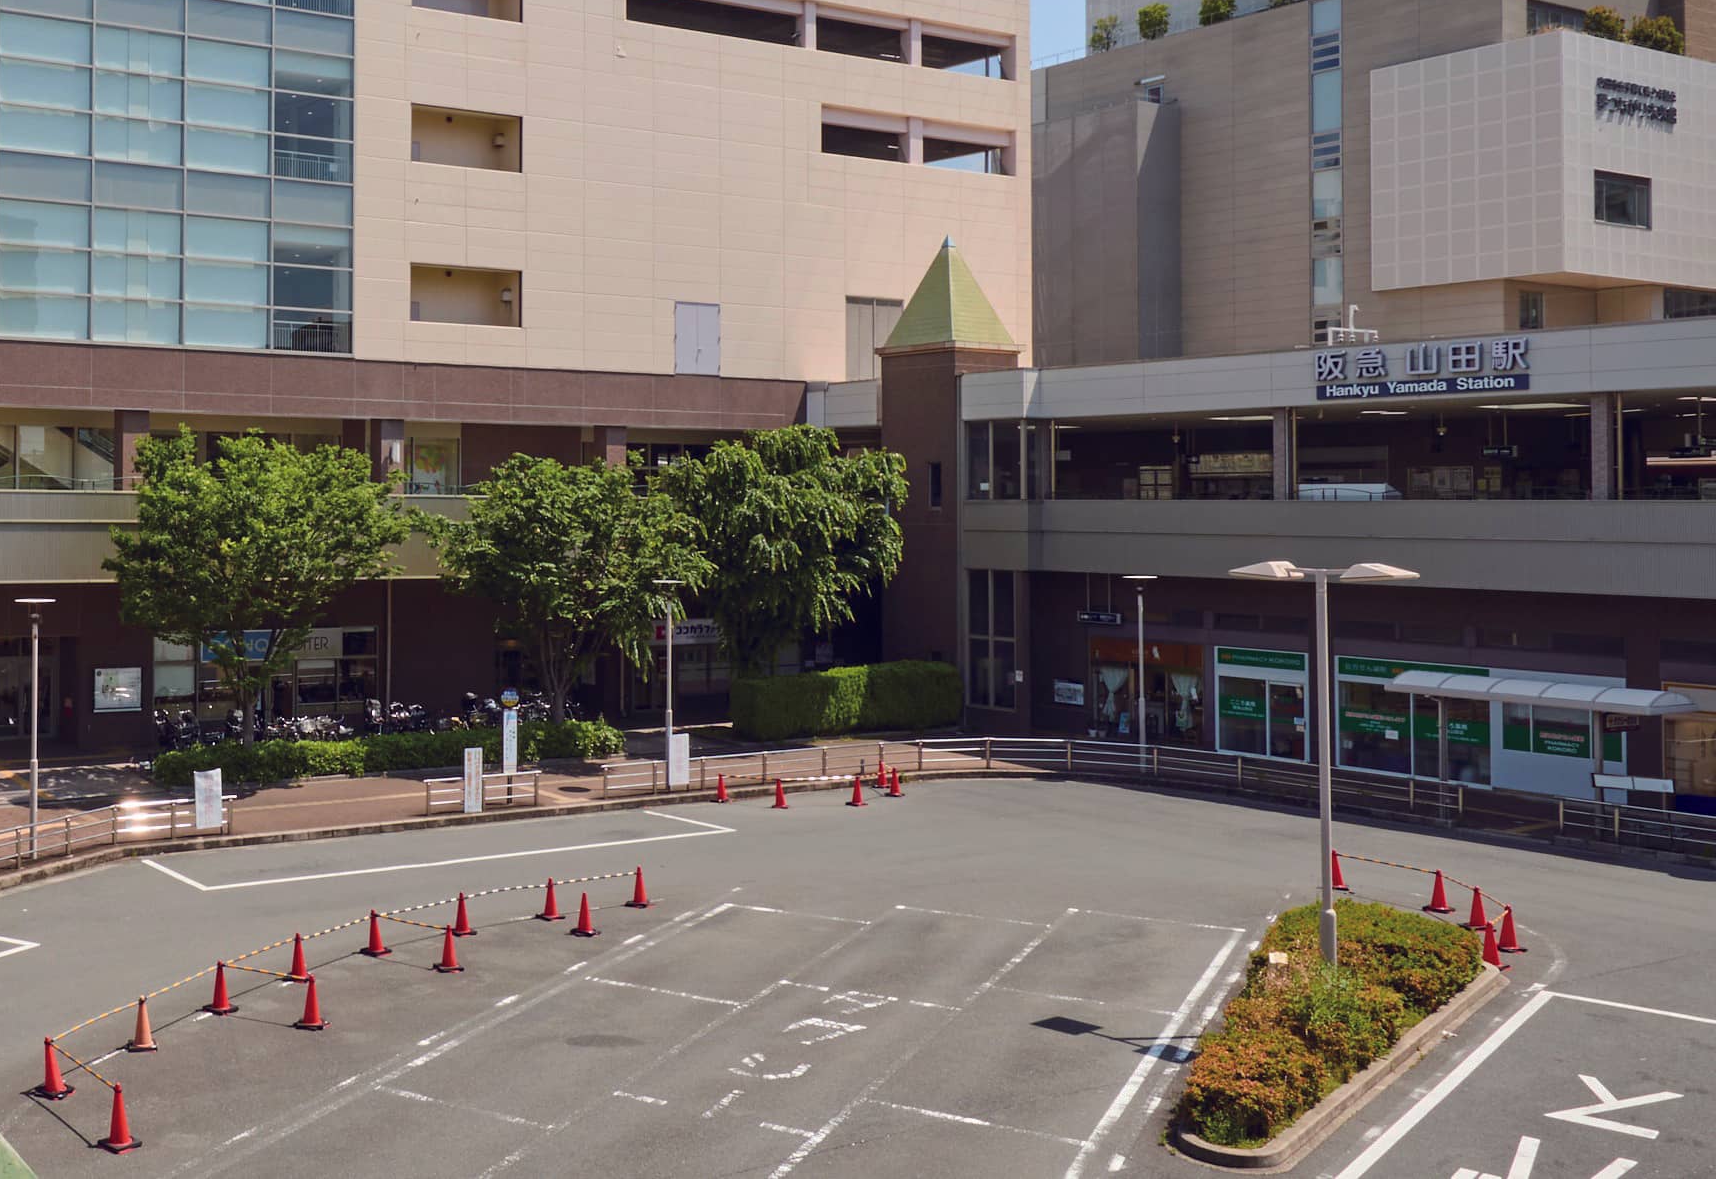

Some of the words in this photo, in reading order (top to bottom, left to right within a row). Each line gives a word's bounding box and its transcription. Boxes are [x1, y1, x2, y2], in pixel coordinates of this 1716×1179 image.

[1326, 385, 1380, 398] Hankyu
[1387, 380, 1448, 394] Yamada
[1456, 376, 1515, 390] Station
